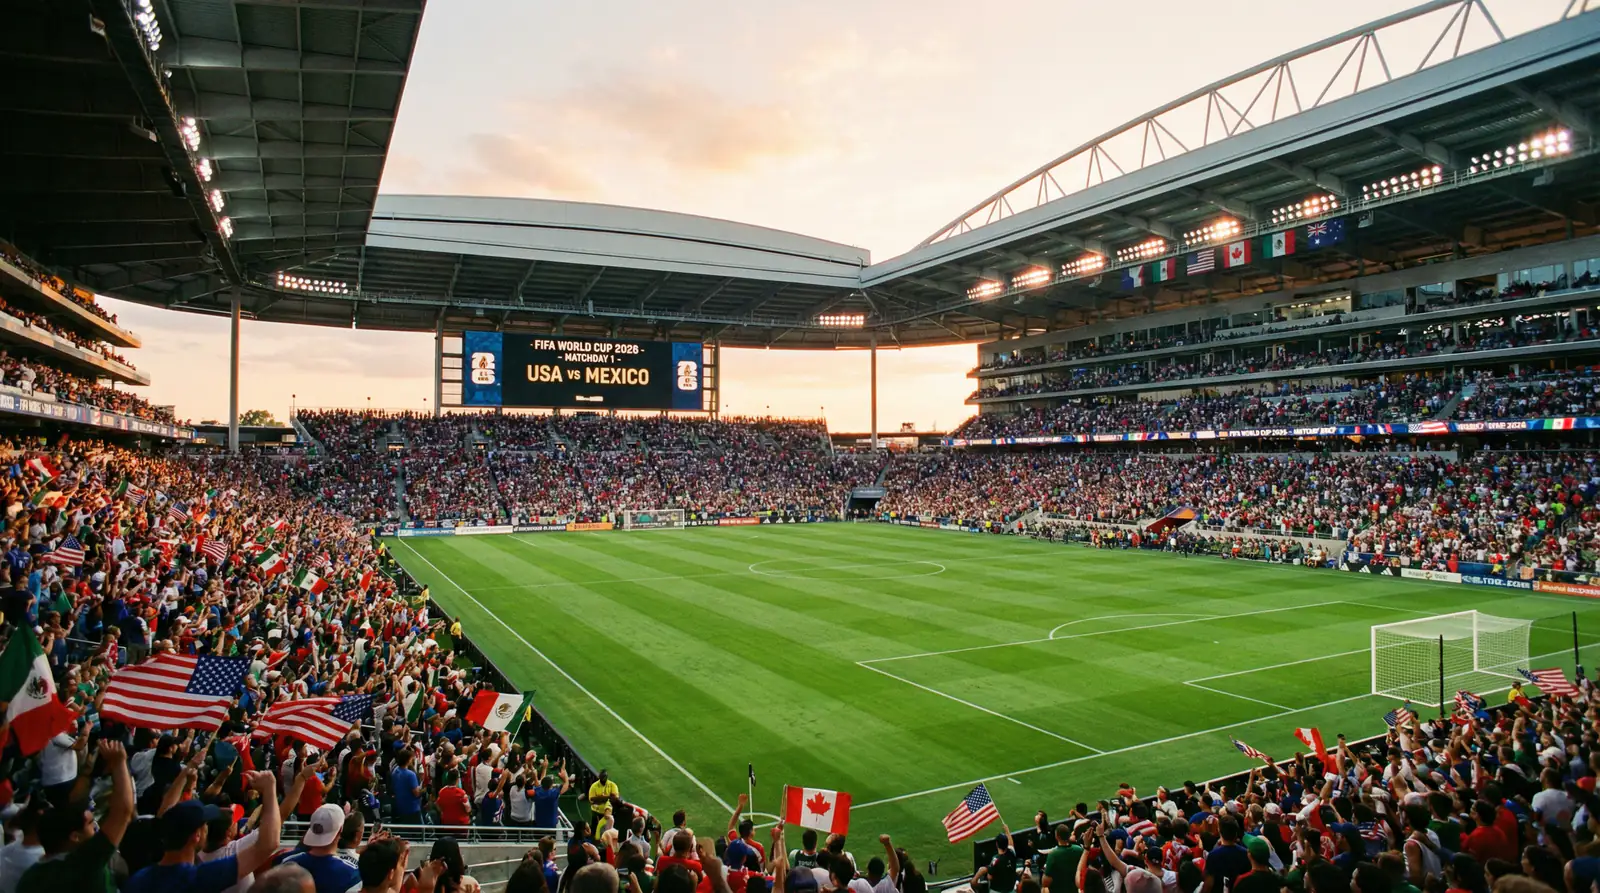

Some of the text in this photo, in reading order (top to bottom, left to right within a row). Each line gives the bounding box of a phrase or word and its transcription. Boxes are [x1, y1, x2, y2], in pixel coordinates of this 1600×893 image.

[534, 340, 556, 350] FIFA
[558, 341, 592, 352] WORLD
[593, 342, 613, 353] CUP
[614, 344, 639, 355] 2026
[564, 352, 609, 363] MATCHDAY
[610, 355, 615, 363] 1
[527, 364, 564, 383] USA
[585, 366, 650, 385] MEXICO
